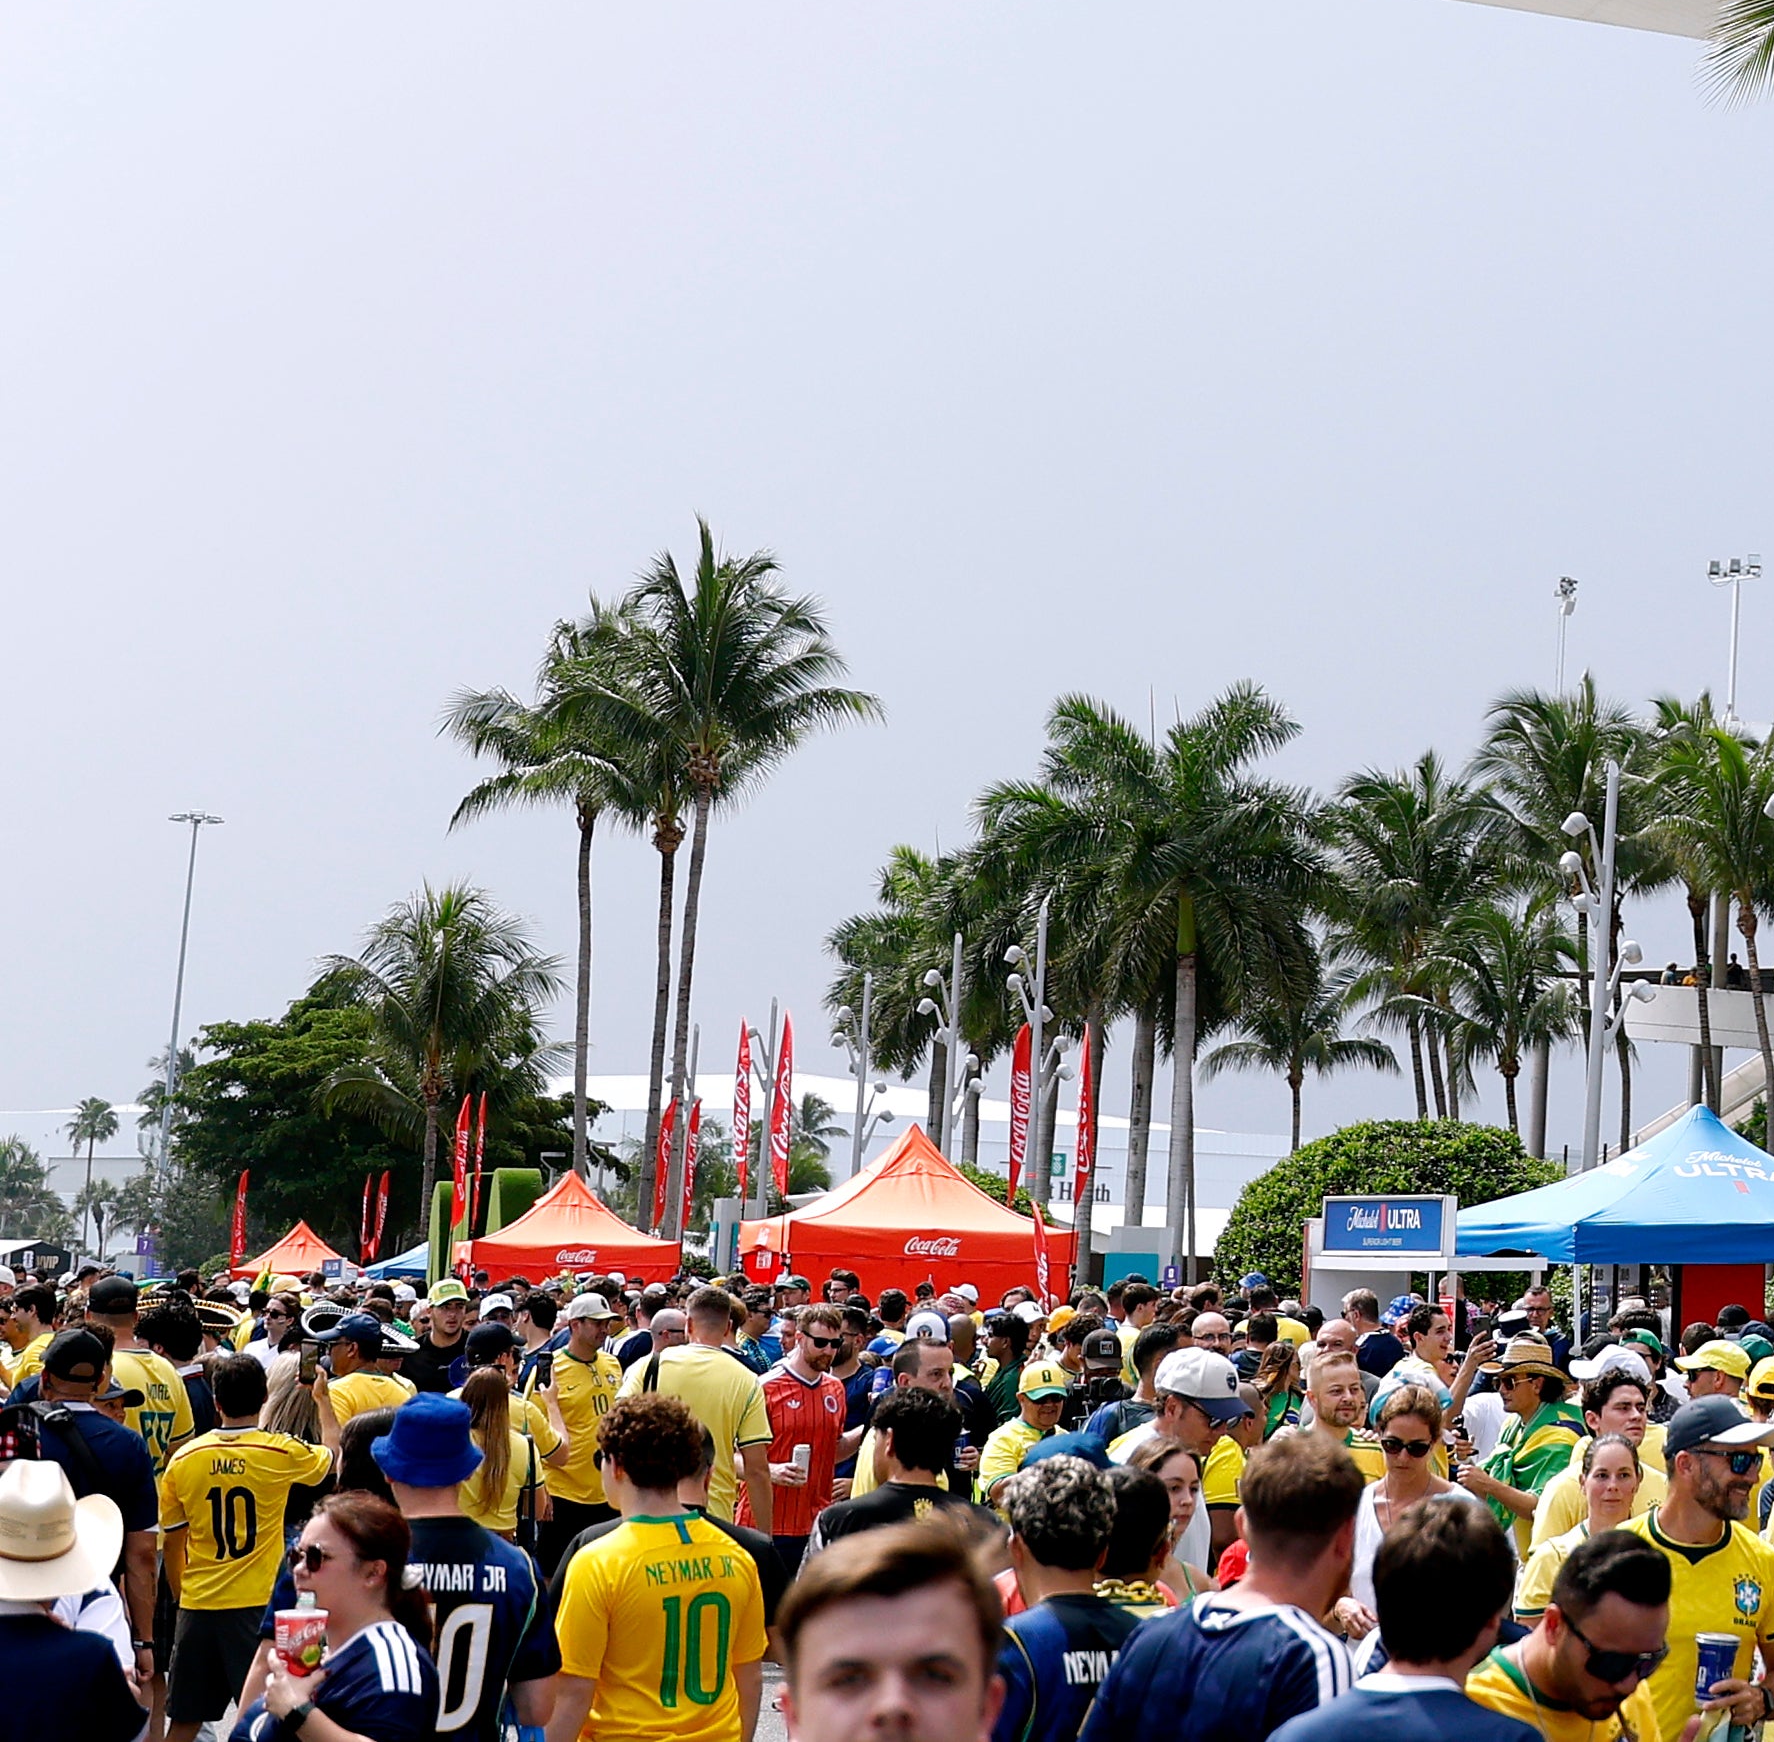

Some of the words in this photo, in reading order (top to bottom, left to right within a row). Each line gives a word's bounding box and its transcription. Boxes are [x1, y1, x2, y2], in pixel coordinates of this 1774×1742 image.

[1686, 1151, 1762, 1168] Michelob
[1059, 1182, 1110, 1202] Hth
[1388, 1209, 1421, 1229] ULTRA
[904, 1236, 962, 1256] Coca-Cola
[555, 1249, 597, 1265] Coca-Cola
[592, 1394, 608, 1416] 10
[209, 1458, 246, 1475] JAMES
[206, 1485, 257, 1560] 10
[421, 1564, 474, 1591] YMAR
[482, 1565, 506, 1592] JR
[646, 1560, 713, 1587] NEYMAR
[719, 1556, 736, 1578] JR
[660, 1591, 731, 1708] 10
